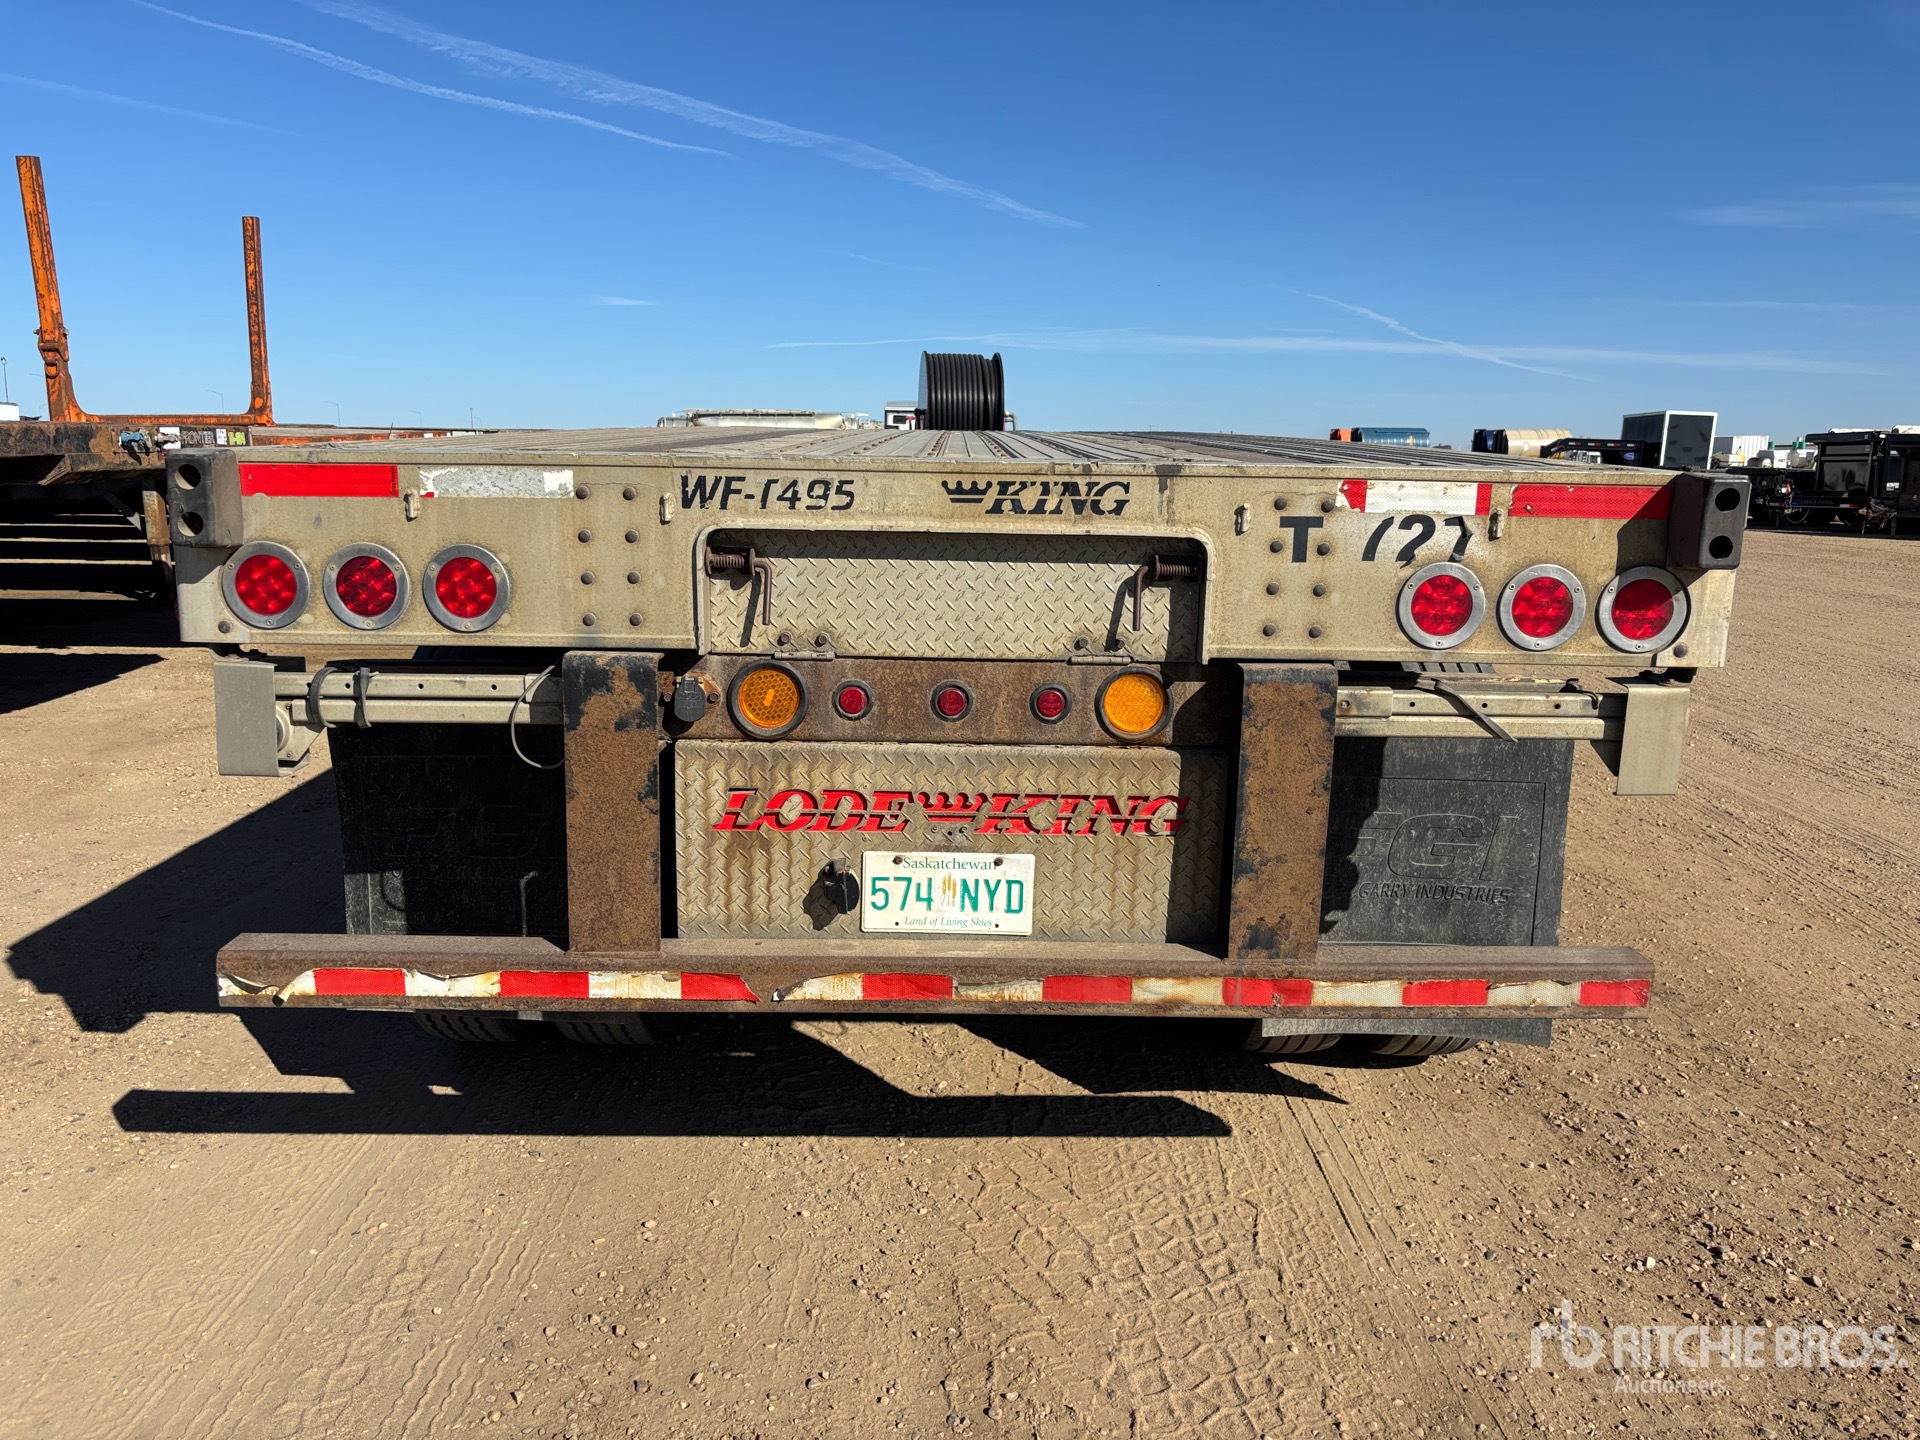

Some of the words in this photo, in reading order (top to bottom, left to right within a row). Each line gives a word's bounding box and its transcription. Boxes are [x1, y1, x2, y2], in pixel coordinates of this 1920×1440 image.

[984, 480, 1131, 516] KING
[1279, 515, 1325, 564] T
[711, 788, 914, 833] LODE
[973, 794, 1191, 837] KING
[902, 856, 997, 870] Saskatchewan
[870, 876, 934, 912] 574
[959, 878, 1025, 915] NYD
[1358, 882, 1407, 899] GARRY
[1414, 883, 1513, 904] INDUSTRIES
[904, 916, 928, 927] Land
[929, 917, 939, 929] of
[940, 917, 968, 930] Living
[970, 917, 993, 930] Skies
